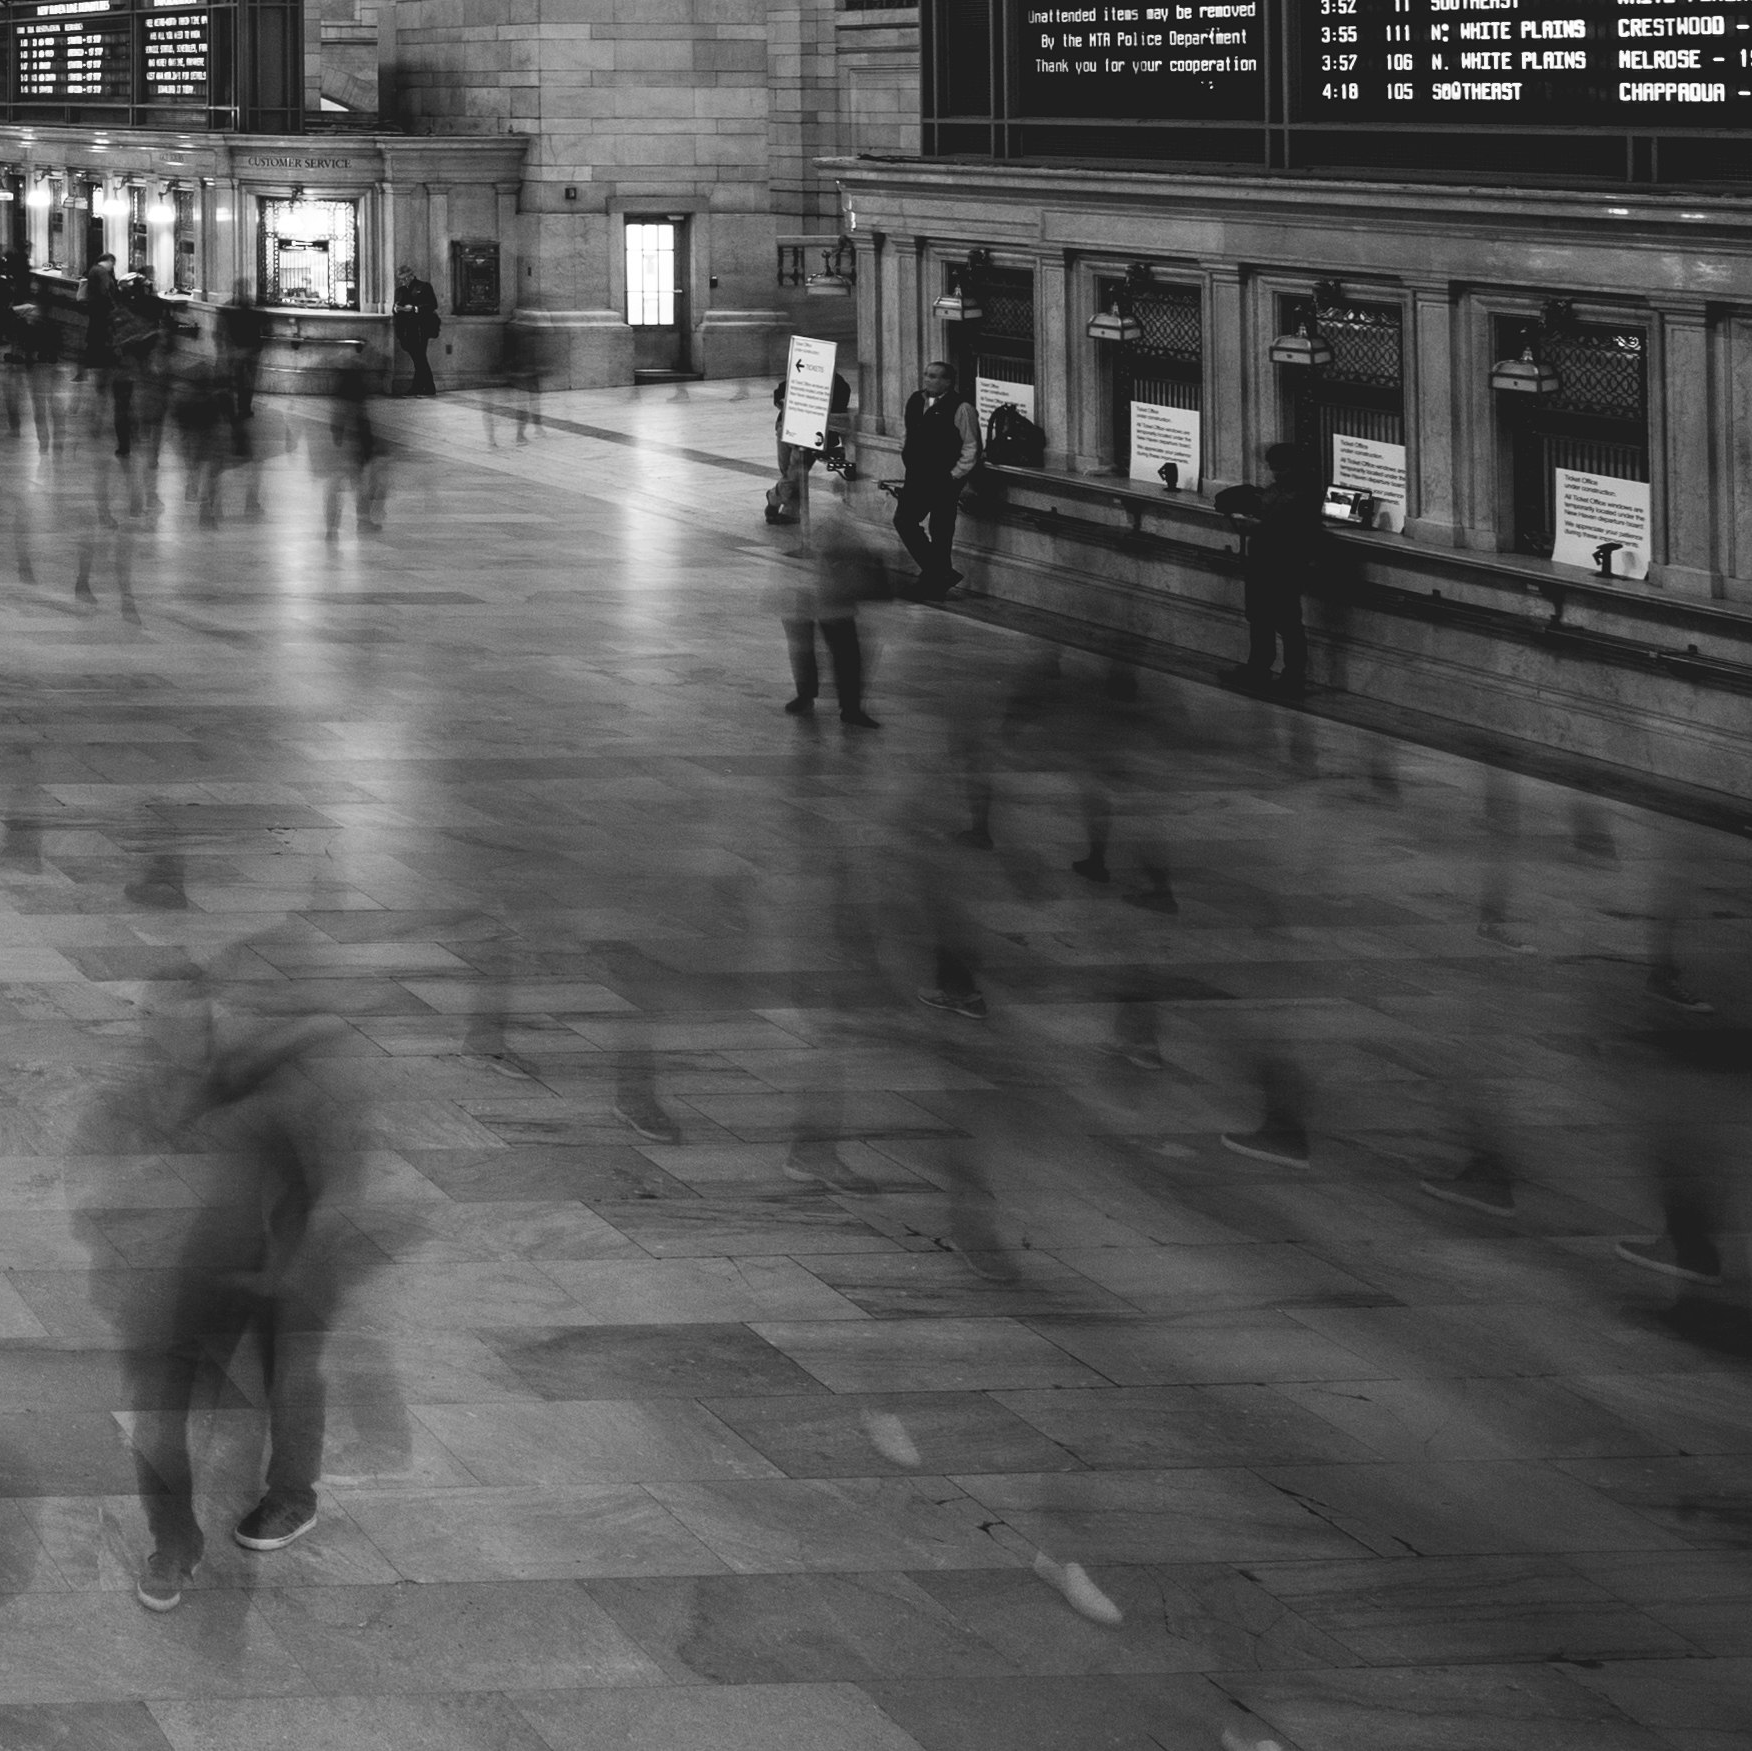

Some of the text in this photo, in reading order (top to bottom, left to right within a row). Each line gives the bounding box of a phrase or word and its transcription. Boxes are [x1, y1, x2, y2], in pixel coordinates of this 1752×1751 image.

[1028, 1, 1256, 23] Unattended items may be removed
[1041, 29, 1247, 50] By the MTA Police Department
[1321, 26, 1358, 43] 3:55
[1386, 25, 1410, 41] 111
[1460, 22, 1511, 40] WHITE
[1521, 20, 1586, 39] PLAINS
[1618, 16, 1725, 37] CRESTWOOD
[1036, 56, 1257, 75] Thank you for your cooperation
[1322, 54, 1358, 71] 3:57
[1387, 54, 1413, 70] 106
[1431, 54, 1448, 70] N.
[1461, 52, 1512, 70] WHITE
[1521, 51, 1586, 69] PLAINS
[1619, 50, 1701, 69] MELROSE
[1322, 83, 1358, 100] 4:18
[1387, 83, 1413, 100] 105
[1619, 83, 1725, 102] CHAPPAQUA
[248, 157, 353, 169] CUSTOMER SERVICE
